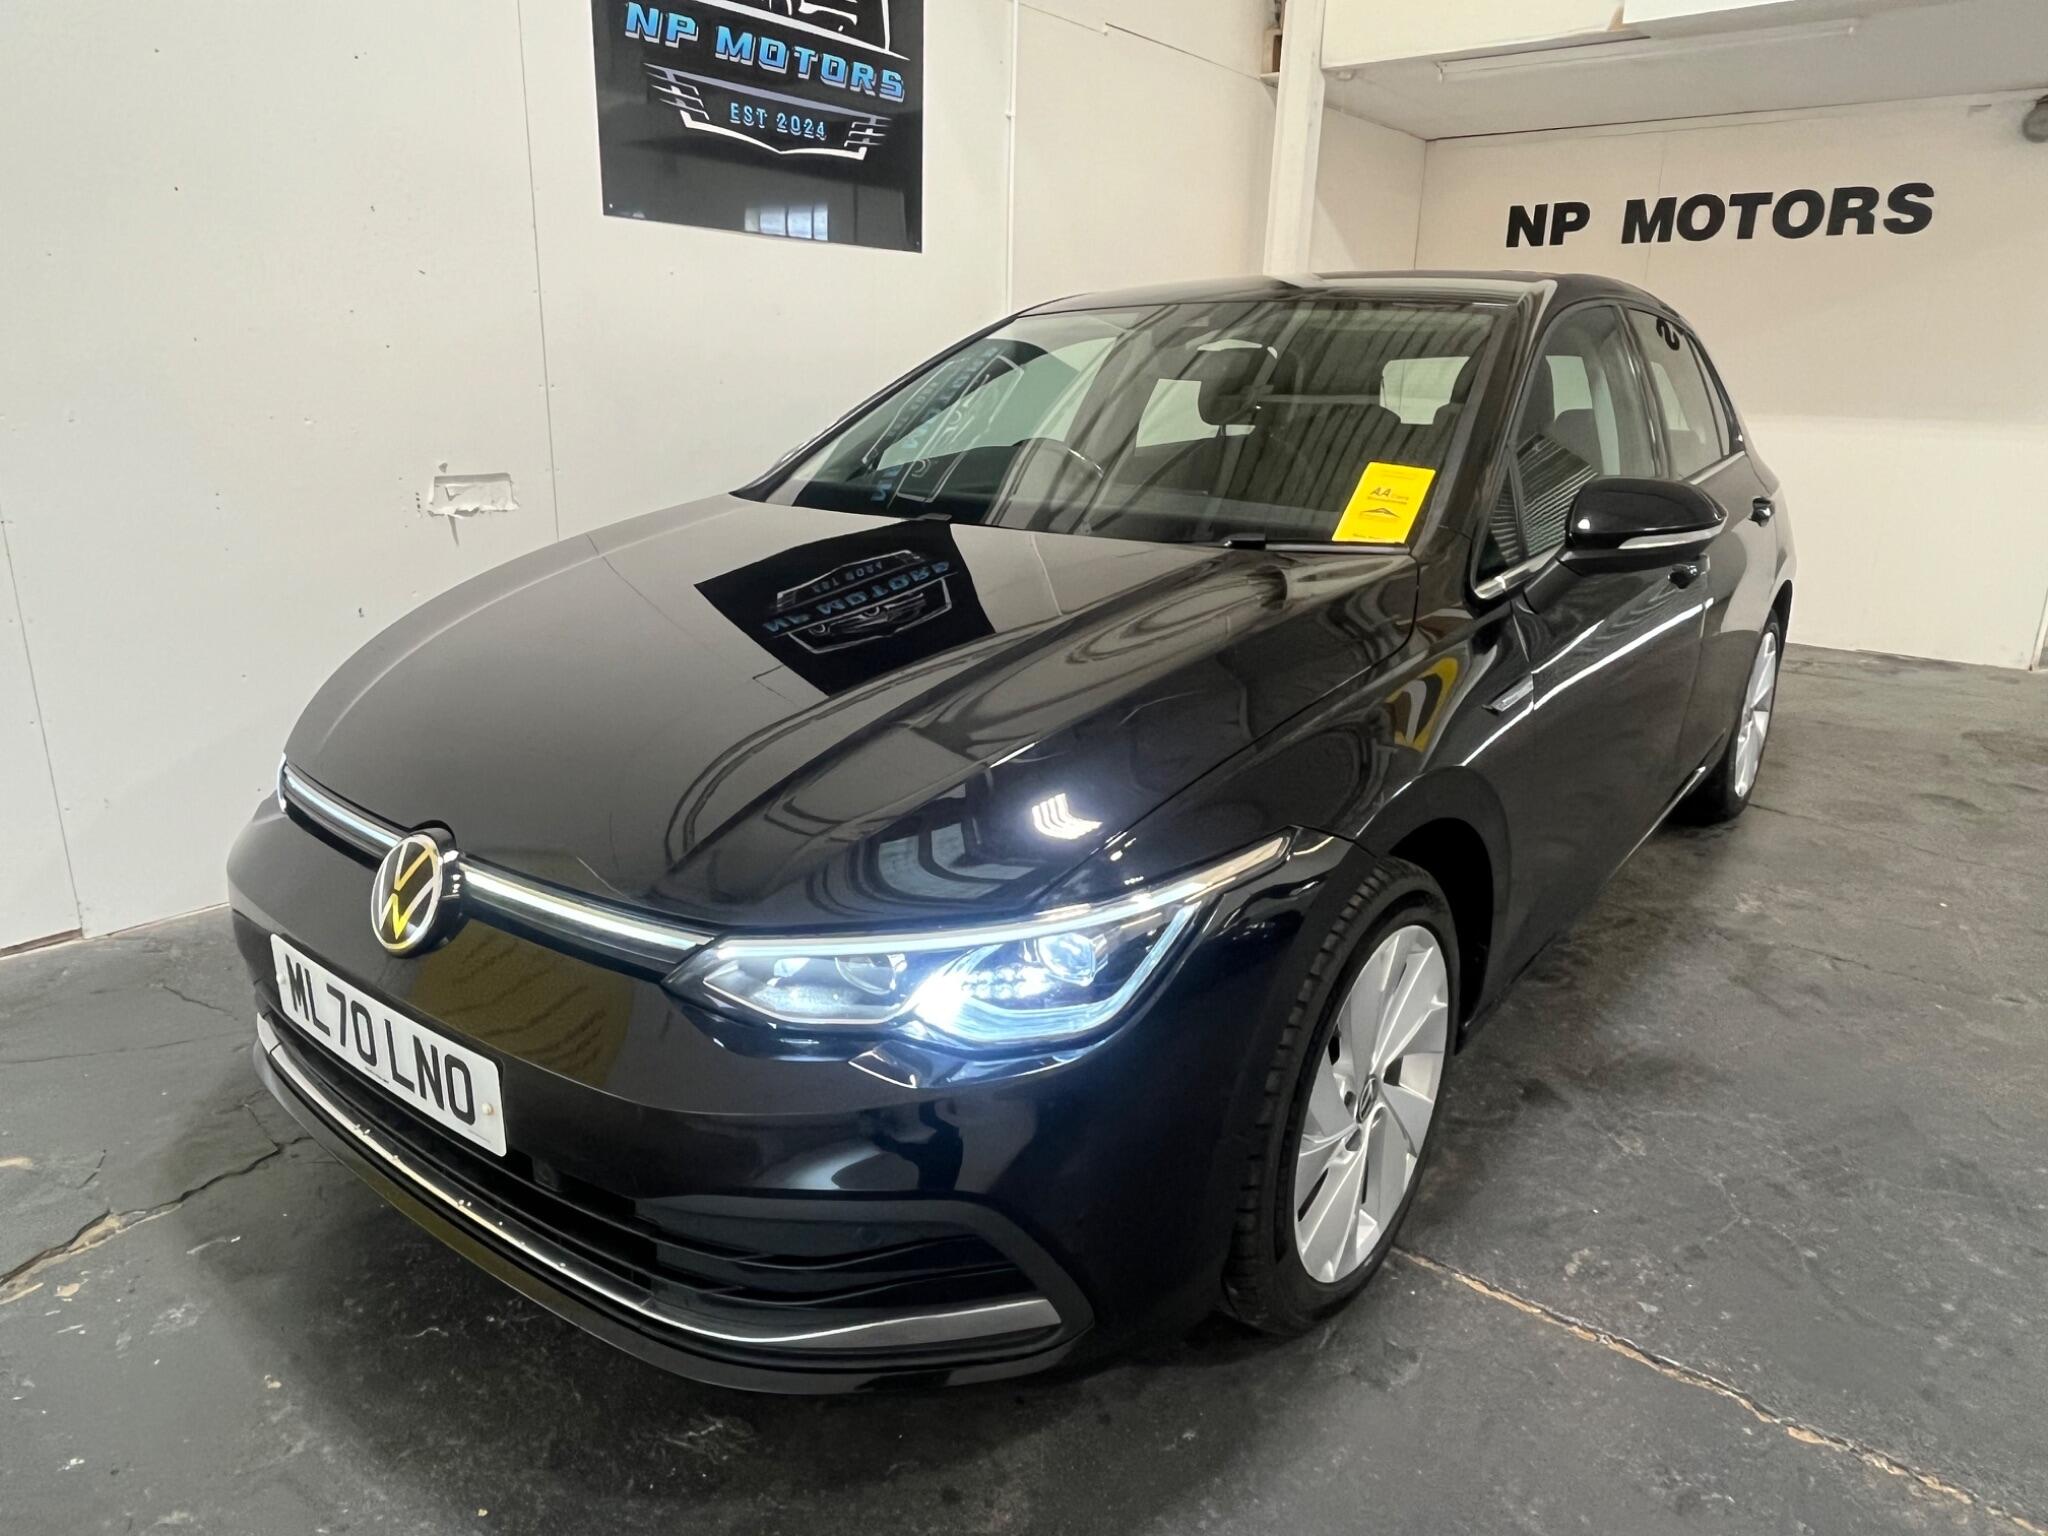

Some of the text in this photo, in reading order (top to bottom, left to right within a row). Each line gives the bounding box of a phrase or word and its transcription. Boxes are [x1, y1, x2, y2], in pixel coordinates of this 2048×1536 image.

[625, 2, 905, 102] NP MOTORS
[728, 102, 828, 140] EST 2024
[1506, 183, 1935, 247] NP MOTORS
[285, 953, 378, 1067] ML70
